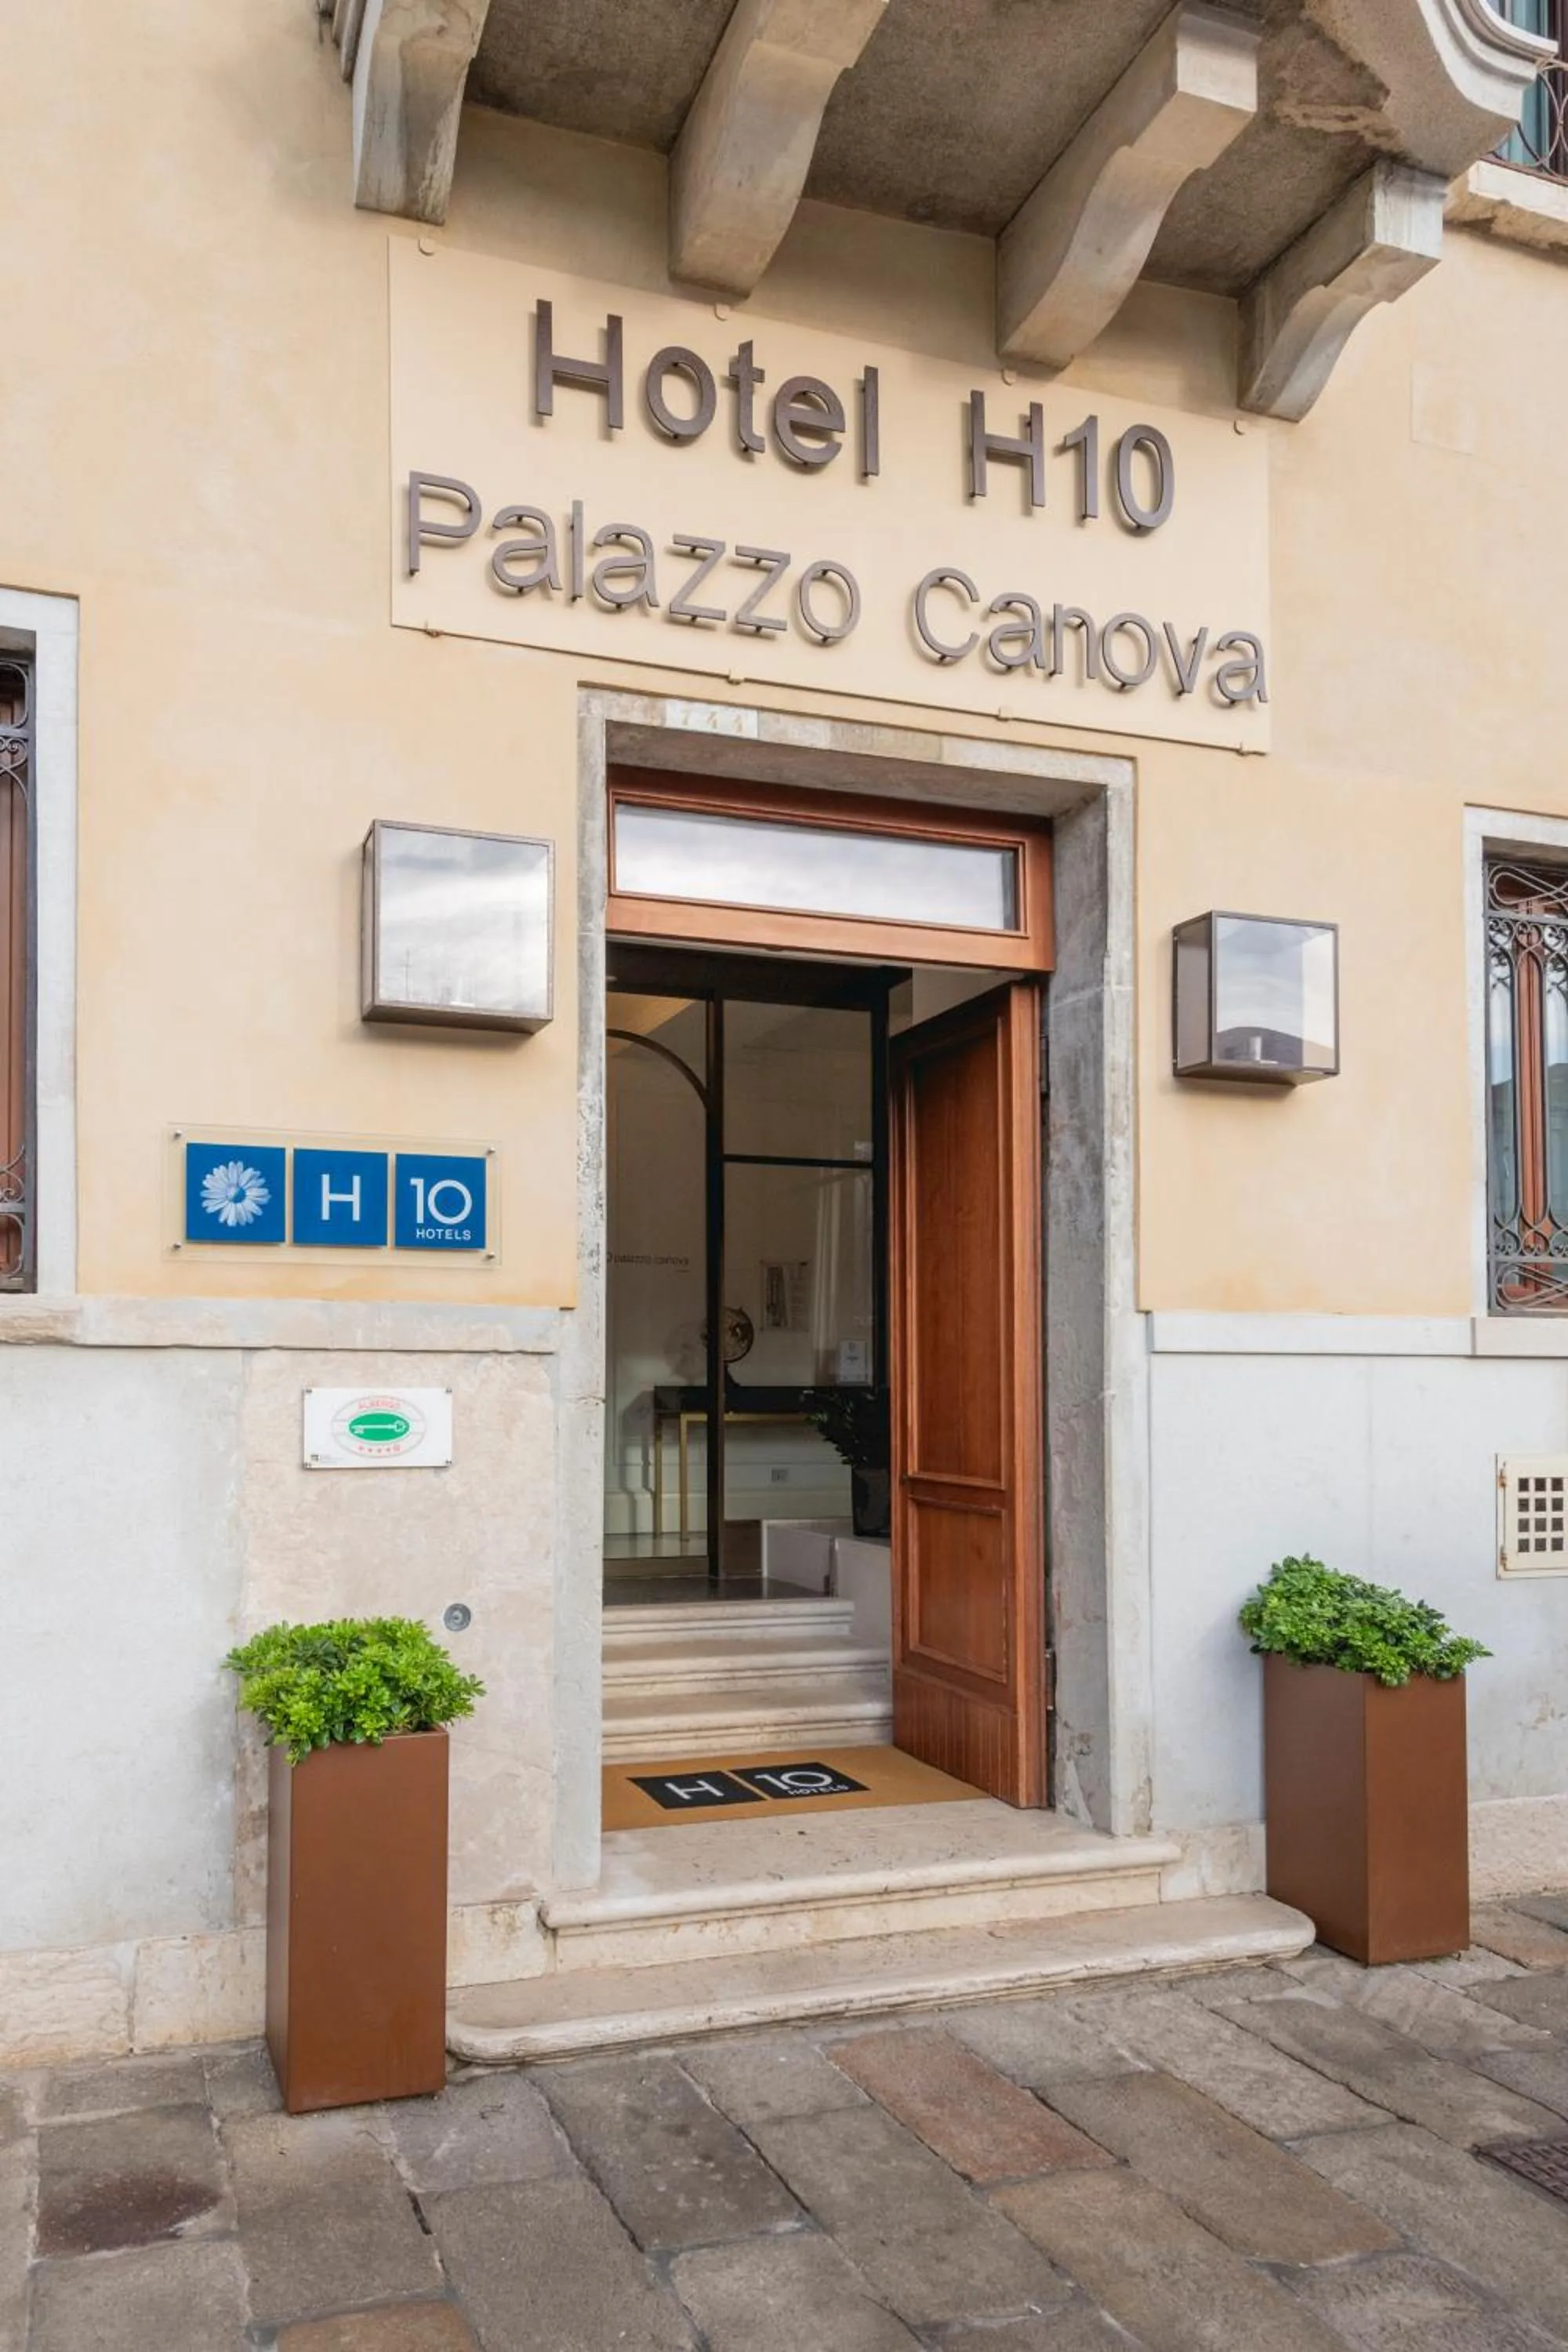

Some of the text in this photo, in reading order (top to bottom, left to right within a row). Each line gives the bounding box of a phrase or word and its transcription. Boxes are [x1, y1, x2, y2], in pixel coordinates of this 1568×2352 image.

[535, 299, 1174, 530] Hotel H10
[407, 470, 1269, 704] Palazzo Canova
[321, 1174, 472, 1225] H 10
[416, 1228, 471, 1241] HOTELS
[665, 1771, 833, 1800] H 10
[787, 1784, 850, 1796] HOTELS
